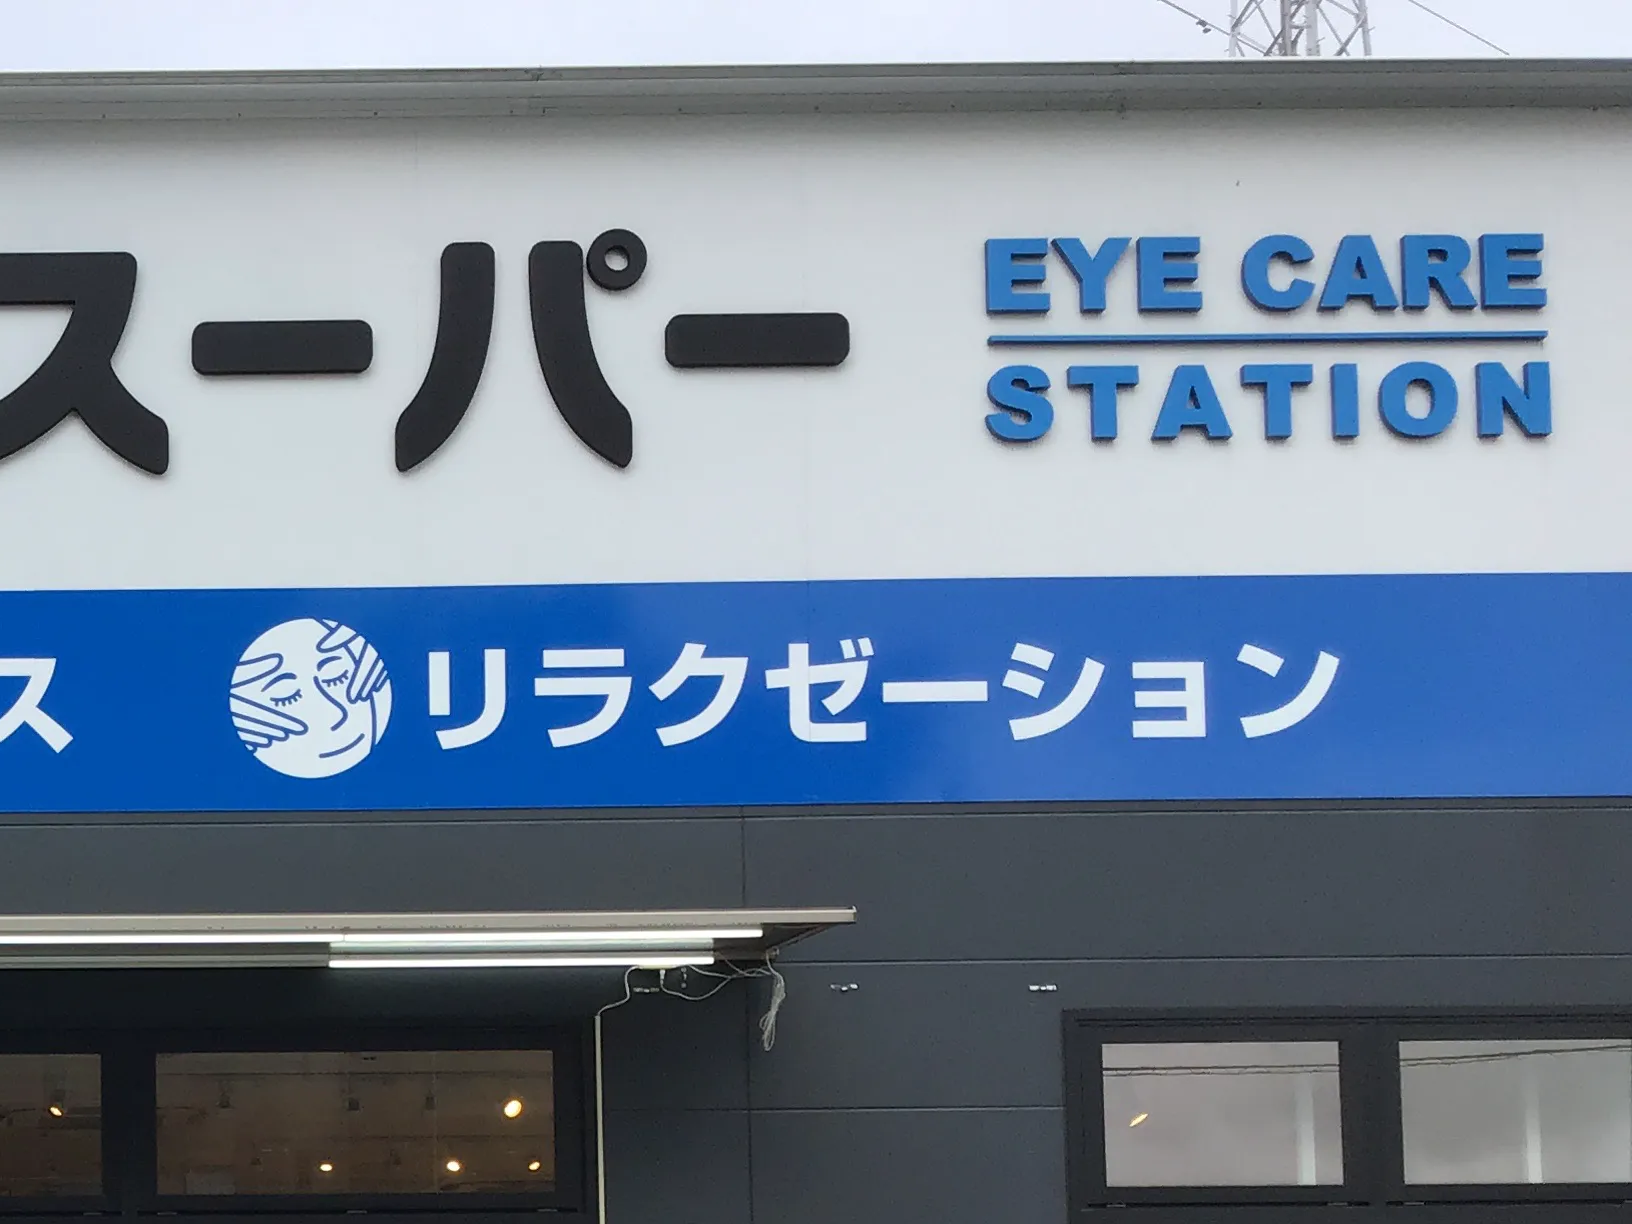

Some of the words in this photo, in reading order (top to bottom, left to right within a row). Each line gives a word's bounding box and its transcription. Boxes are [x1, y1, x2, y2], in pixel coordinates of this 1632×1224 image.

[985, 237, 1204, 314] EYE
[1240, 234, 1547, 312] CARE
[984, 361, 1552, 442] STATION
[427, 637, 1340, 750] リラクゼーション
